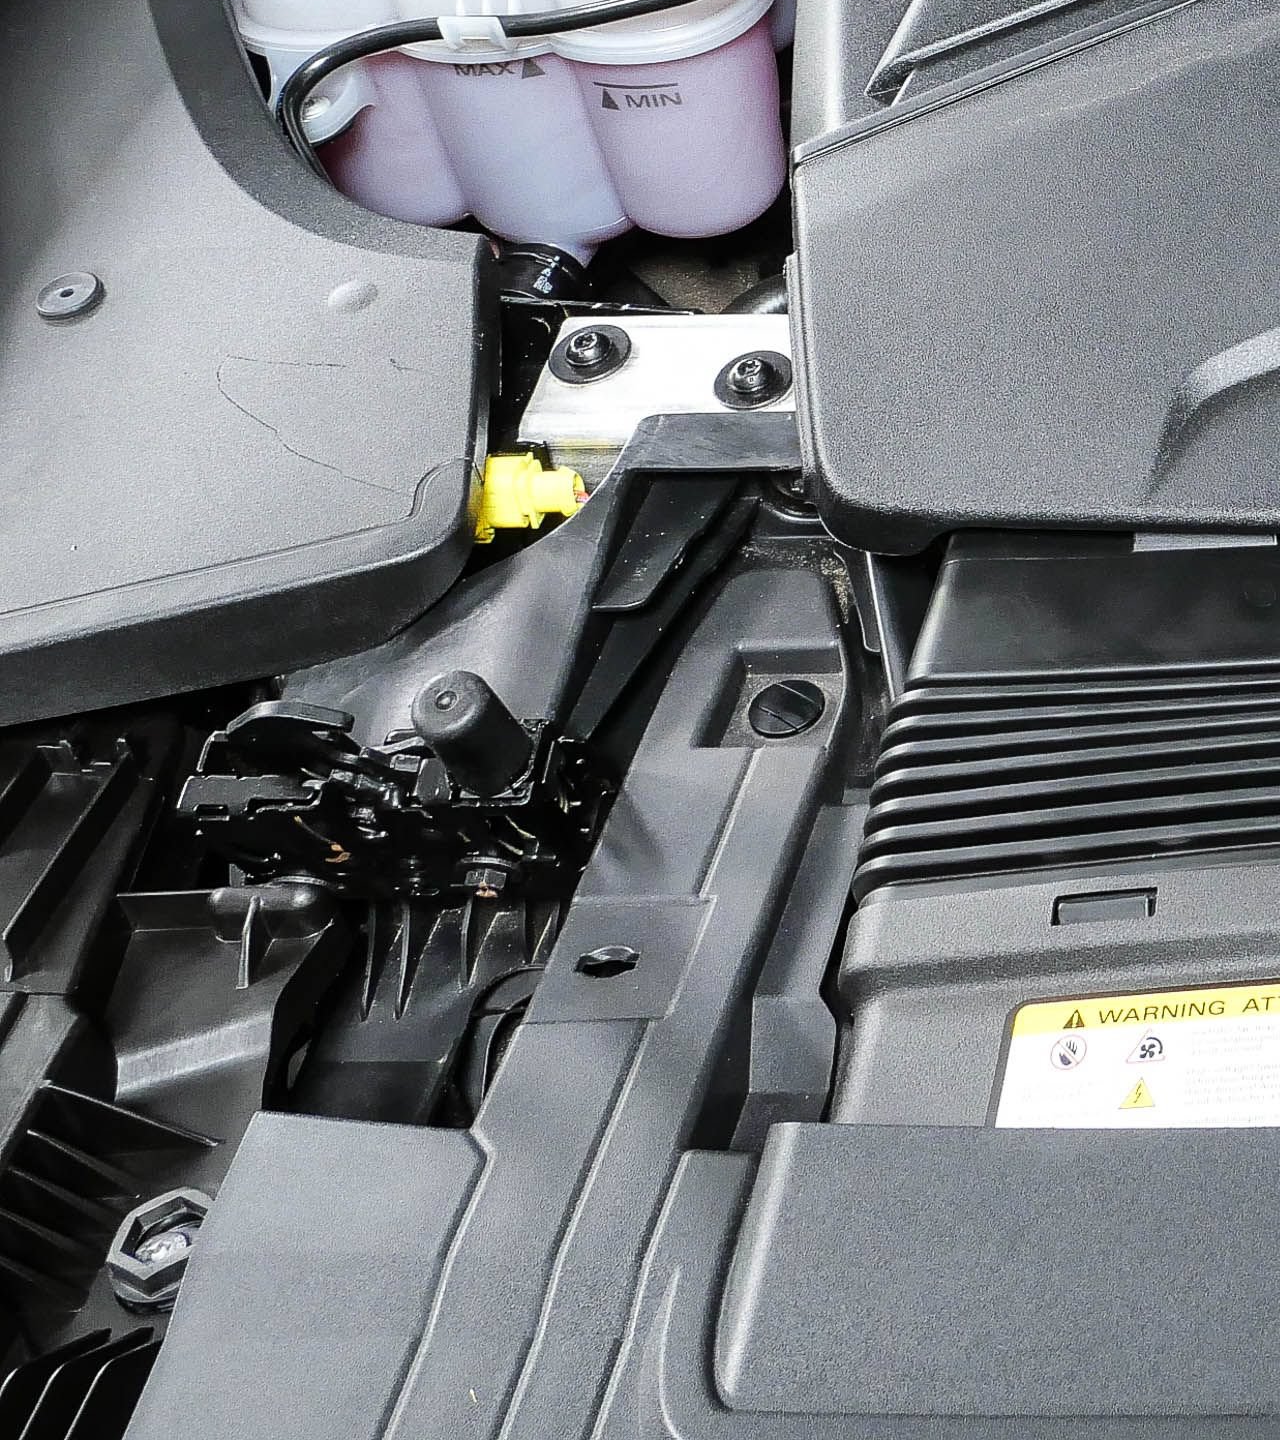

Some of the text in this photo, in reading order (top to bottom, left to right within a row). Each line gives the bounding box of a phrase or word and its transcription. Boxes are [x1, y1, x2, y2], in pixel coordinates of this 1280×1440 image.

[453, 63, 516, 78] MAX
[624, 92, 683, 108] MIN
[1099, 1000, 1225, 1024] WARNING
